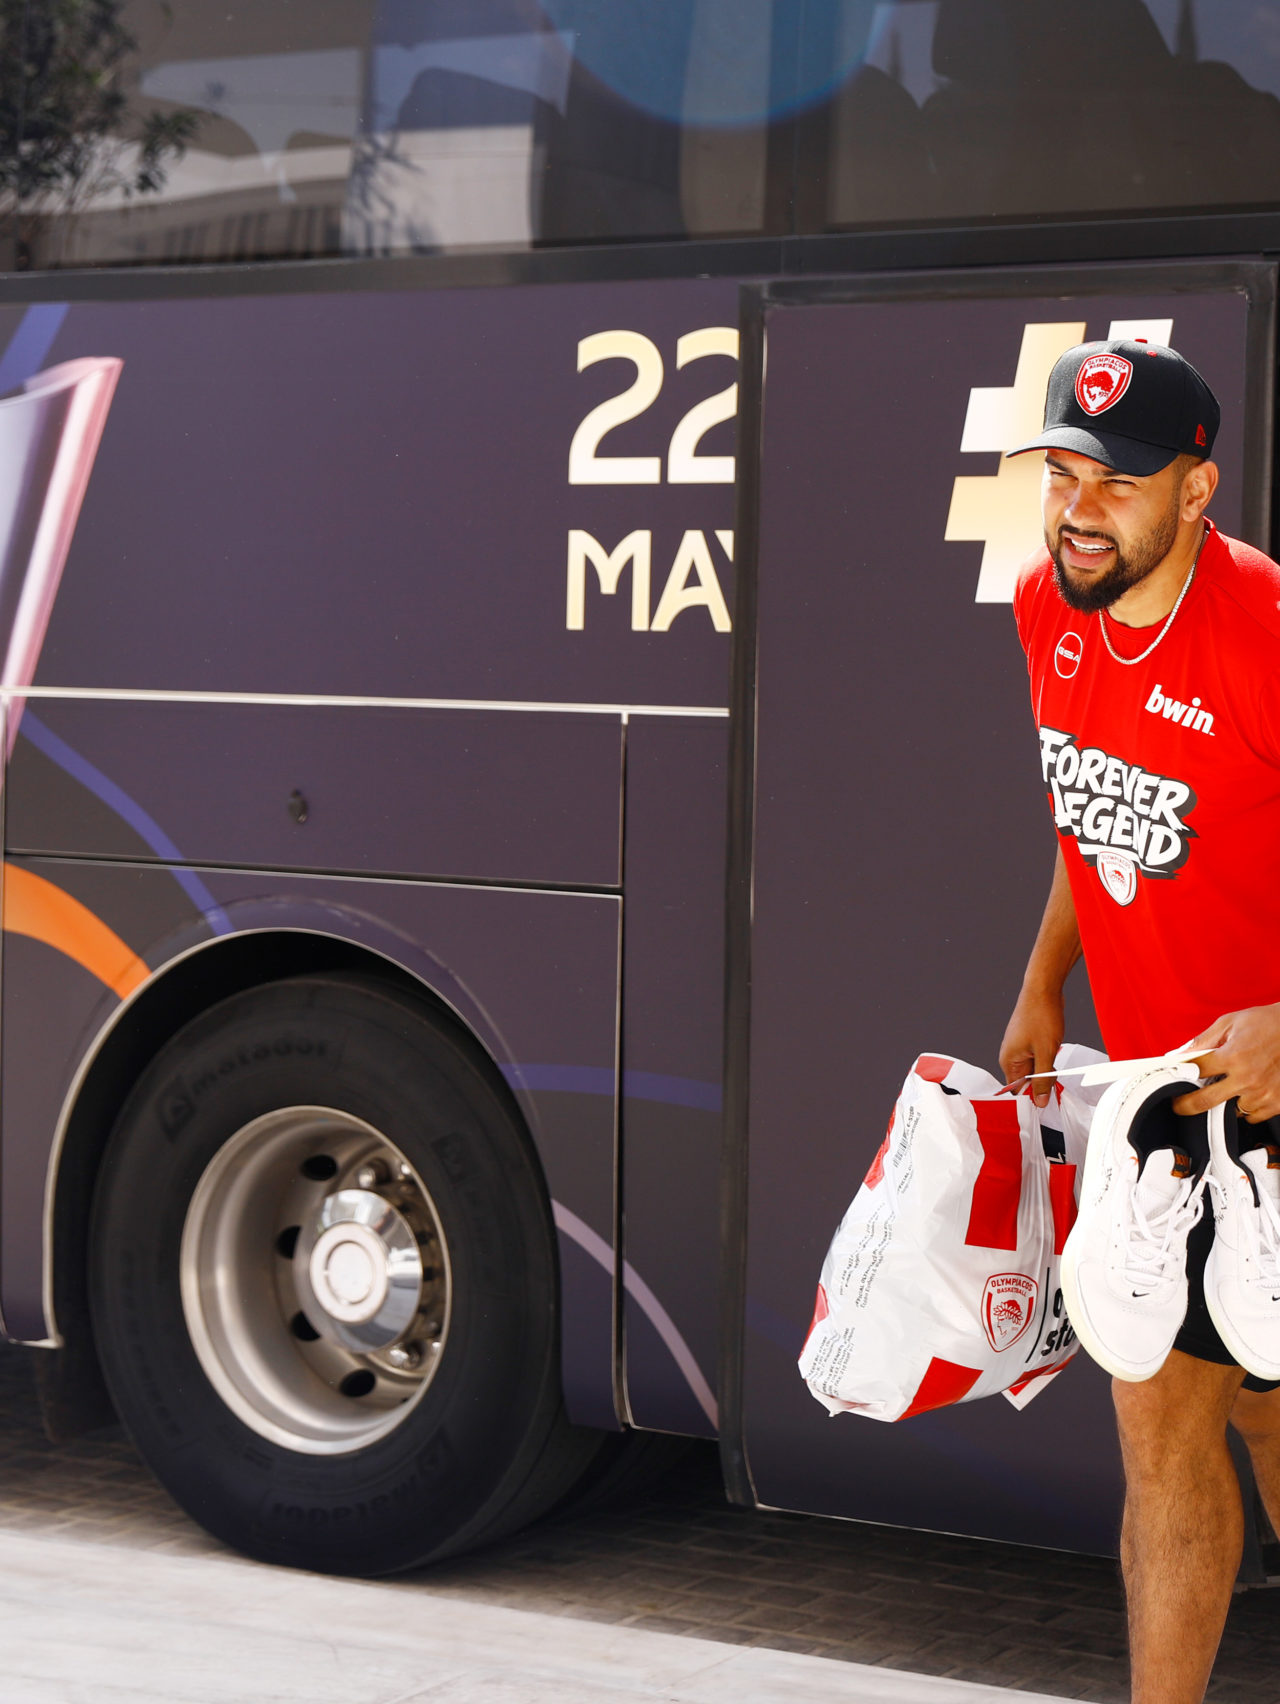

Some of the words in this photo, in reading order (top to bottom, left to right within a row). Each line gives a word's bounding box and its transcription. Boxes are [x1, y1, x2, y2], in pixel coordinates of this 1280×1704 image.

[568, 327, 739, 485] 22
[1087, 357, 1127, 370] OLYMPIACOS
[566, 529, 734, 633] MA
[1039, 726, 1190, 831] FOREVER
[1050, 776, 1182, 866] LEGEND
[990, 1278, 1033, 1292] OLYMPIACOS
[996, 1287, 1027, 1298] BASKETBALL
